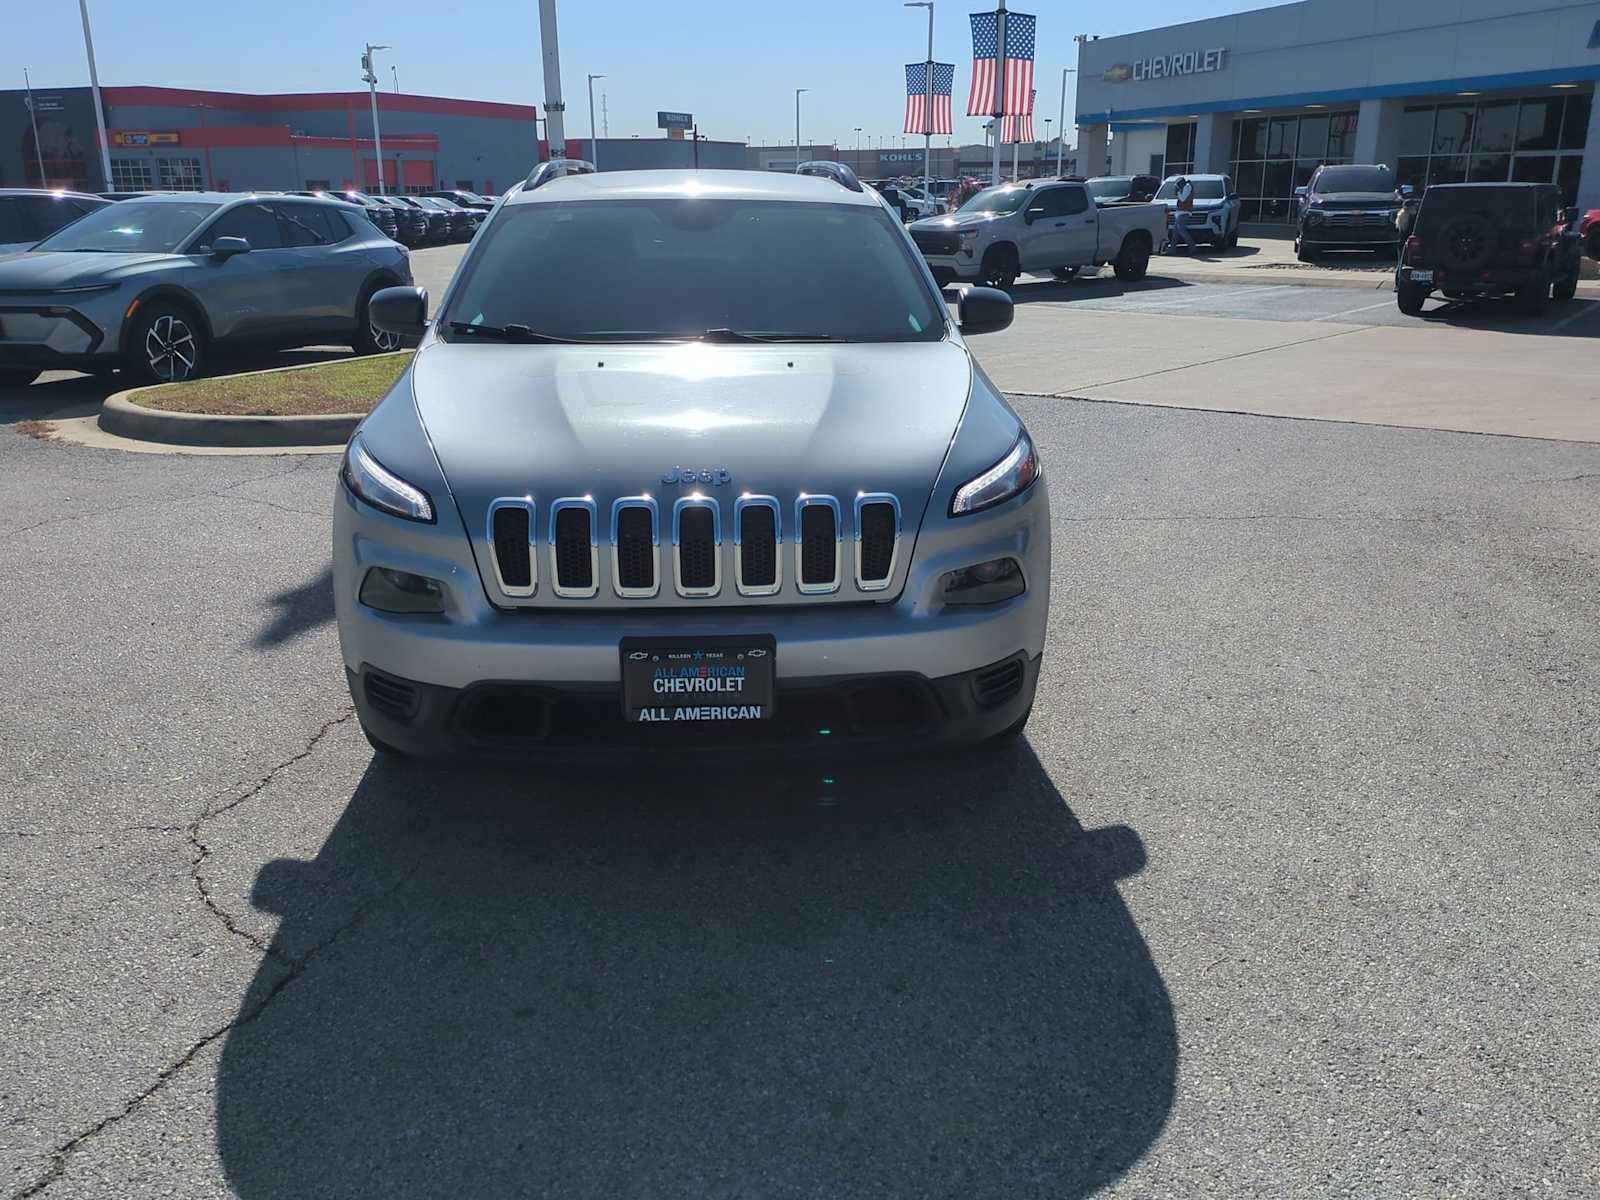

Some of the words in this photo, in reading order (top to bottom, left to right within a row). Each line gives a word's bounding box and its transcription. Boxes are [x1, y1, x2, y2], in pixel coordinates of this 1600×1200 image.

[1132, 48, 1226, 80] CHEVROLET
[880, 152, 923, 161] KOHL'S
[661, 464, 731, 486] Jeep
[655, 667, 679, 678] ALL
[680, 666, 745, 677] AMERICAN
[653, 677, 744, 693] CHEVROLET
[639, 708, 670, 721] ALL
[674, 706, 761, 720] AMERICAN
